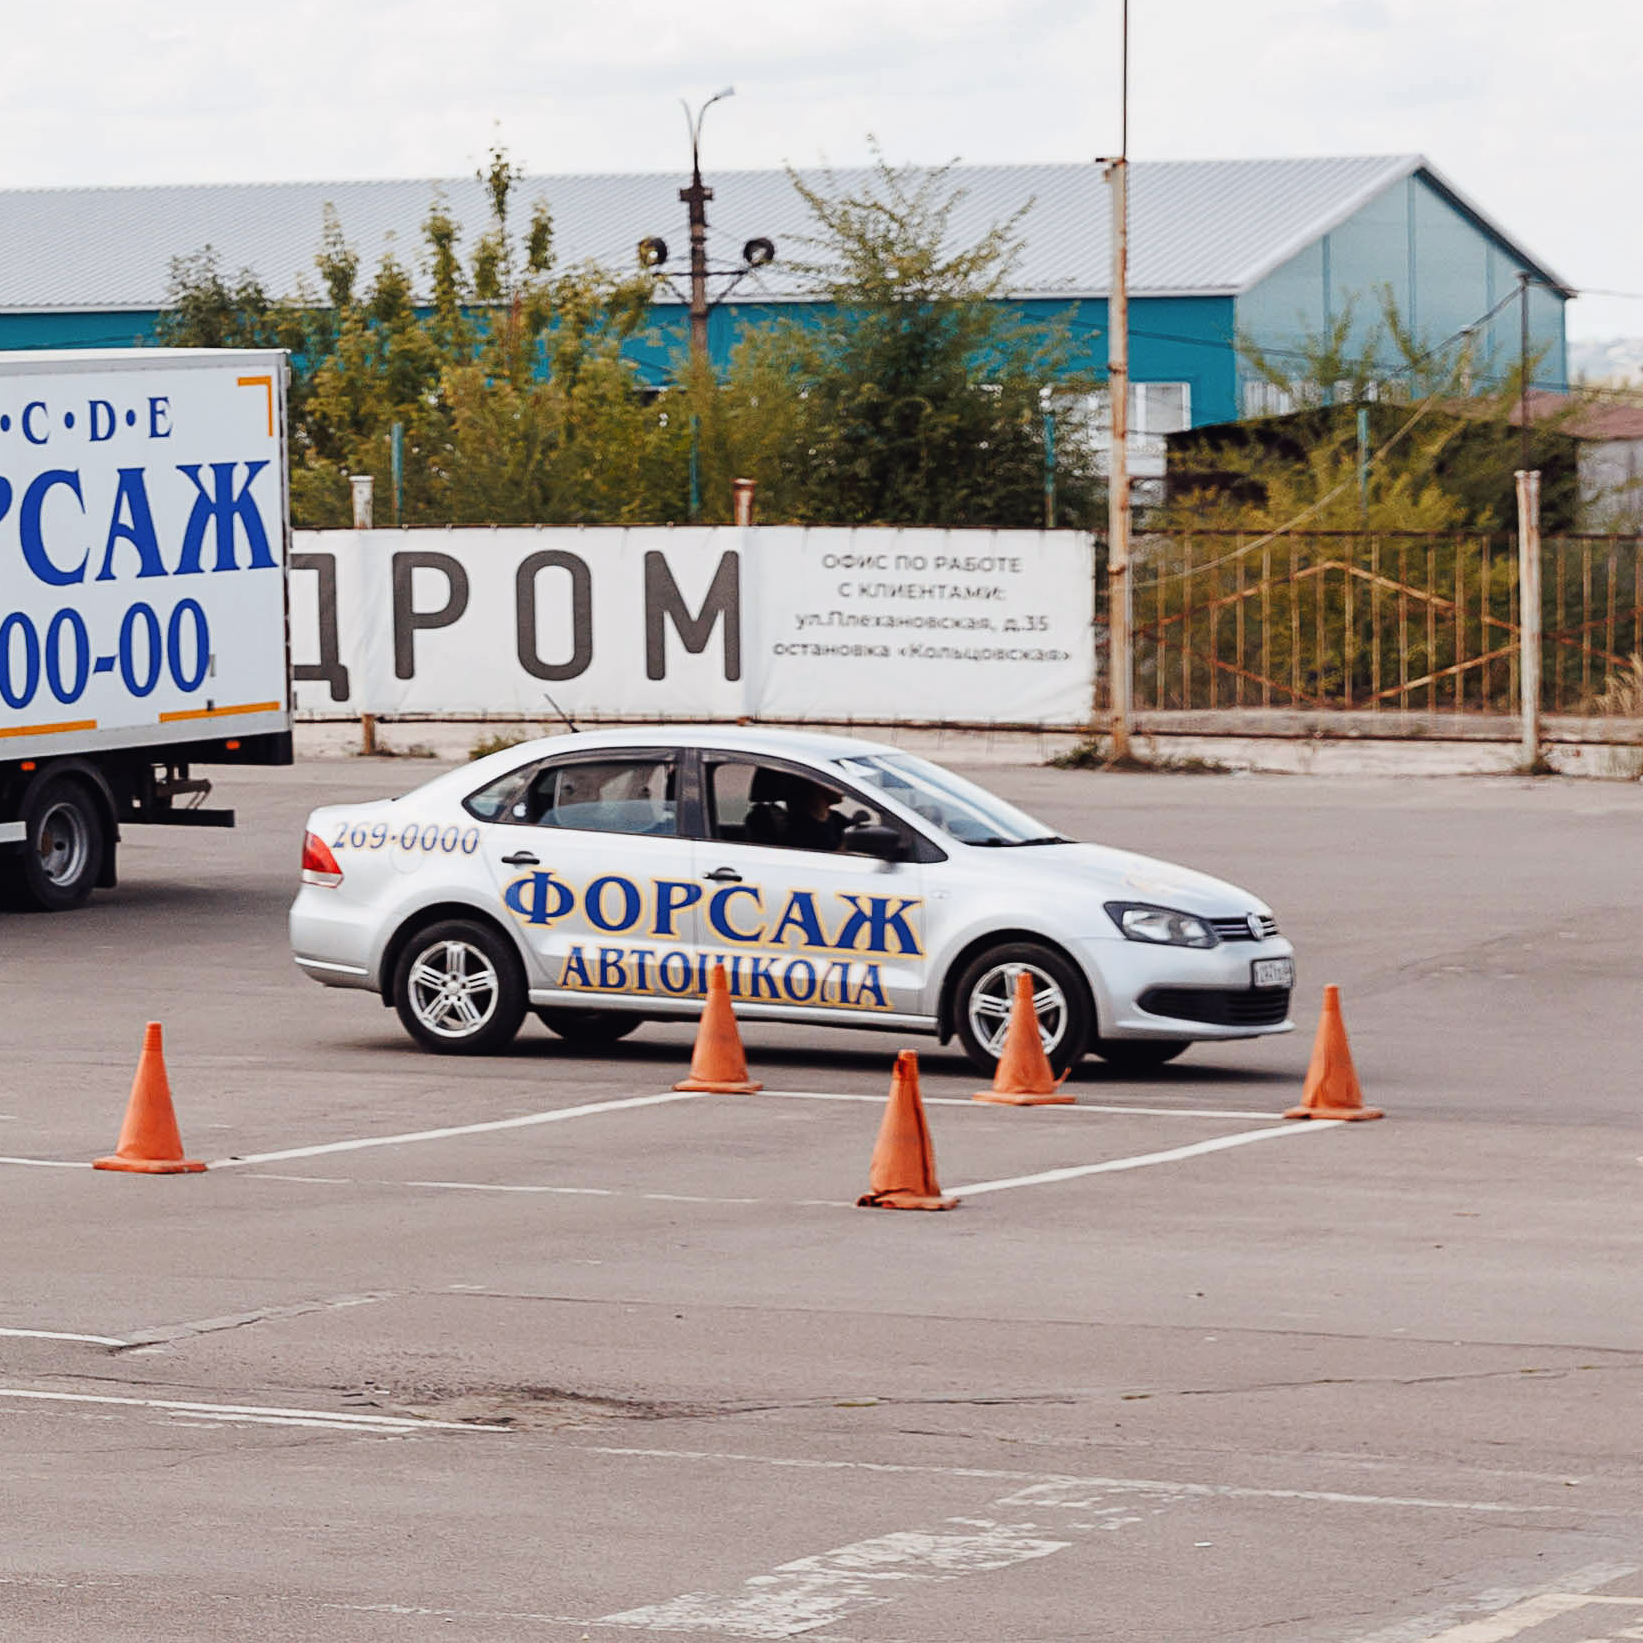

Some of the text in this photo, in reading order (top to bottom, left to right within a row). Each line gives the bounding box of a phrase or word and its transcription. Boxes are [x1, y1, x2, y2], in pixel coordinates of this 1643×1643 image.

[822, 554, 1022, 573] ОФИС ПО РАБОТЕ
[838, 582, 851, 597] С
[773, 643, 890, 657] остановка
[332, 821, 481, 854] 269-0000
[504, 869, 926, 958] ФОРСАЖ
[560, 944, 893, 1009] АВТОШКОЛА
